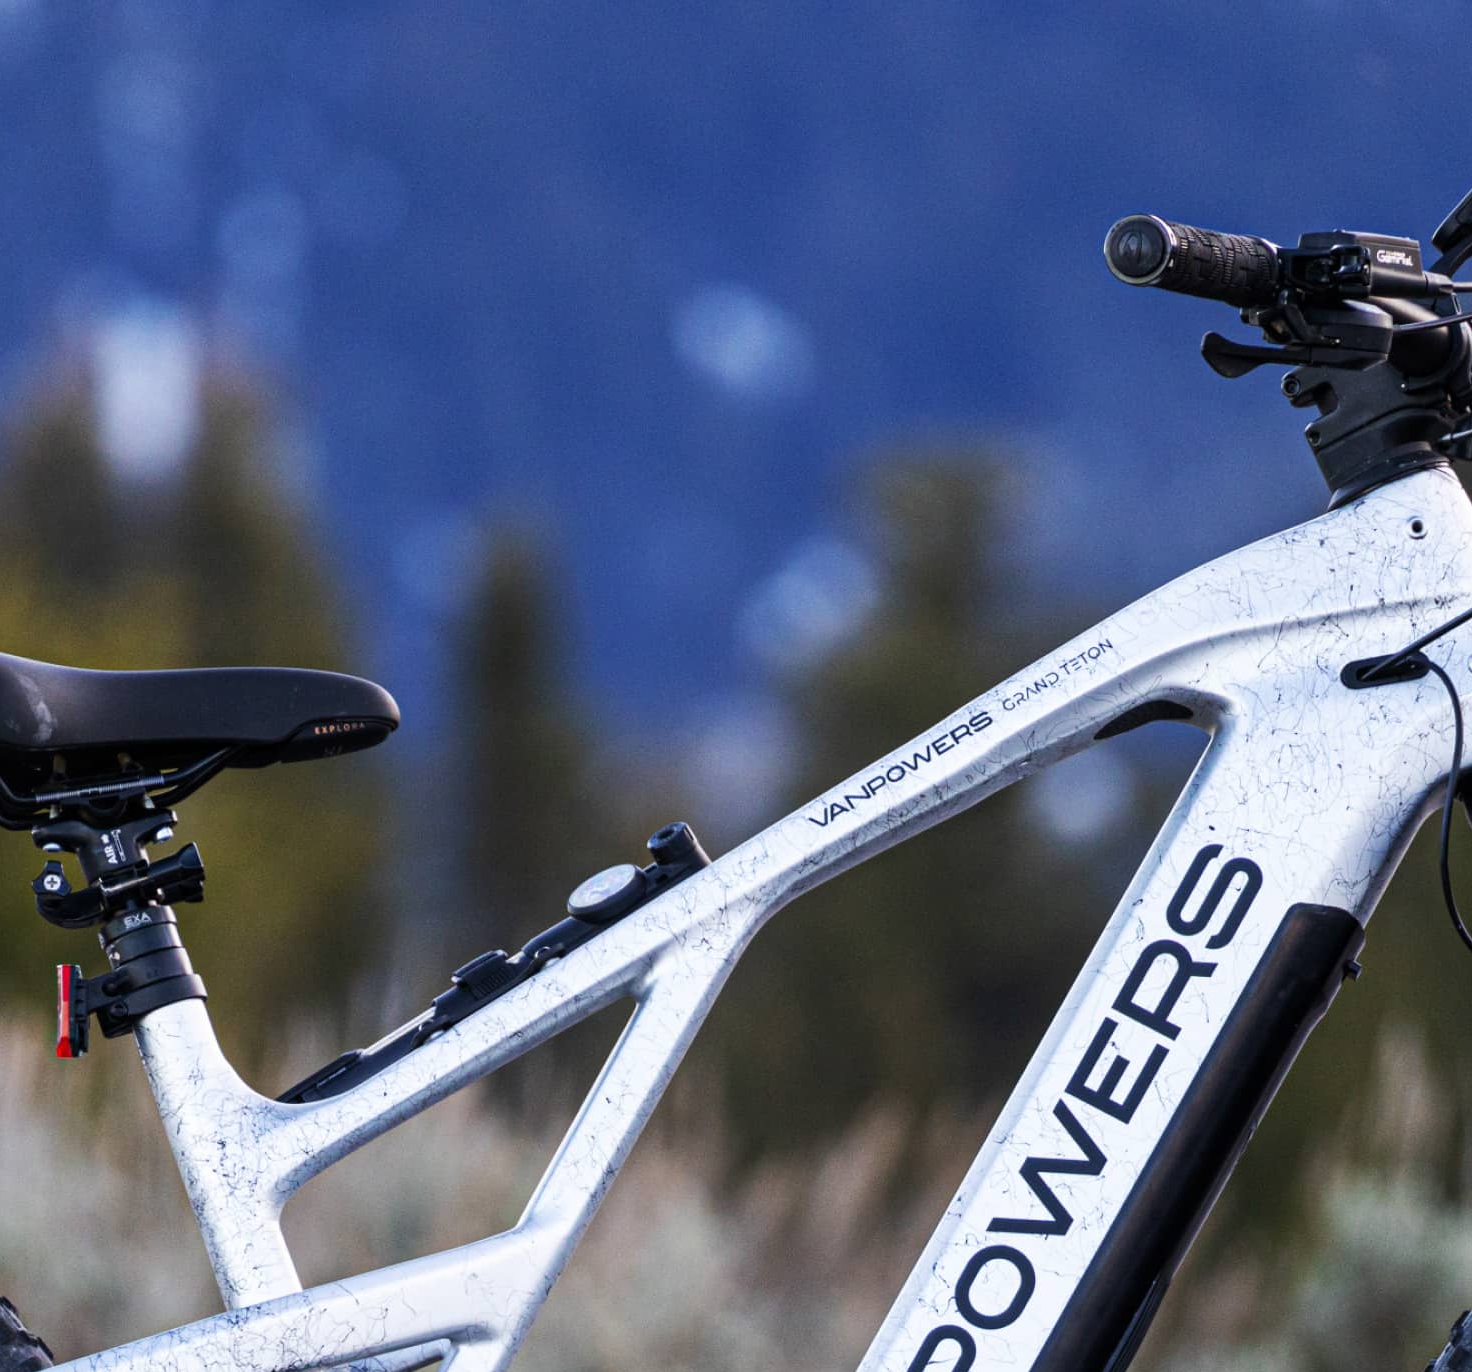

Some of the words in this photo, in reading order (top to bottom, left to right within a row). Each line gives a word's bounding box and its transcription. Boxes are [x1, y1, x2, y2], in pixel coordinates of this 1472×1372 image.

[808, 710, 994, 828] VANPOWERS
[1002, 671, 1060, 712] GRAND
[1059, 638, 1115, 677] TETON
